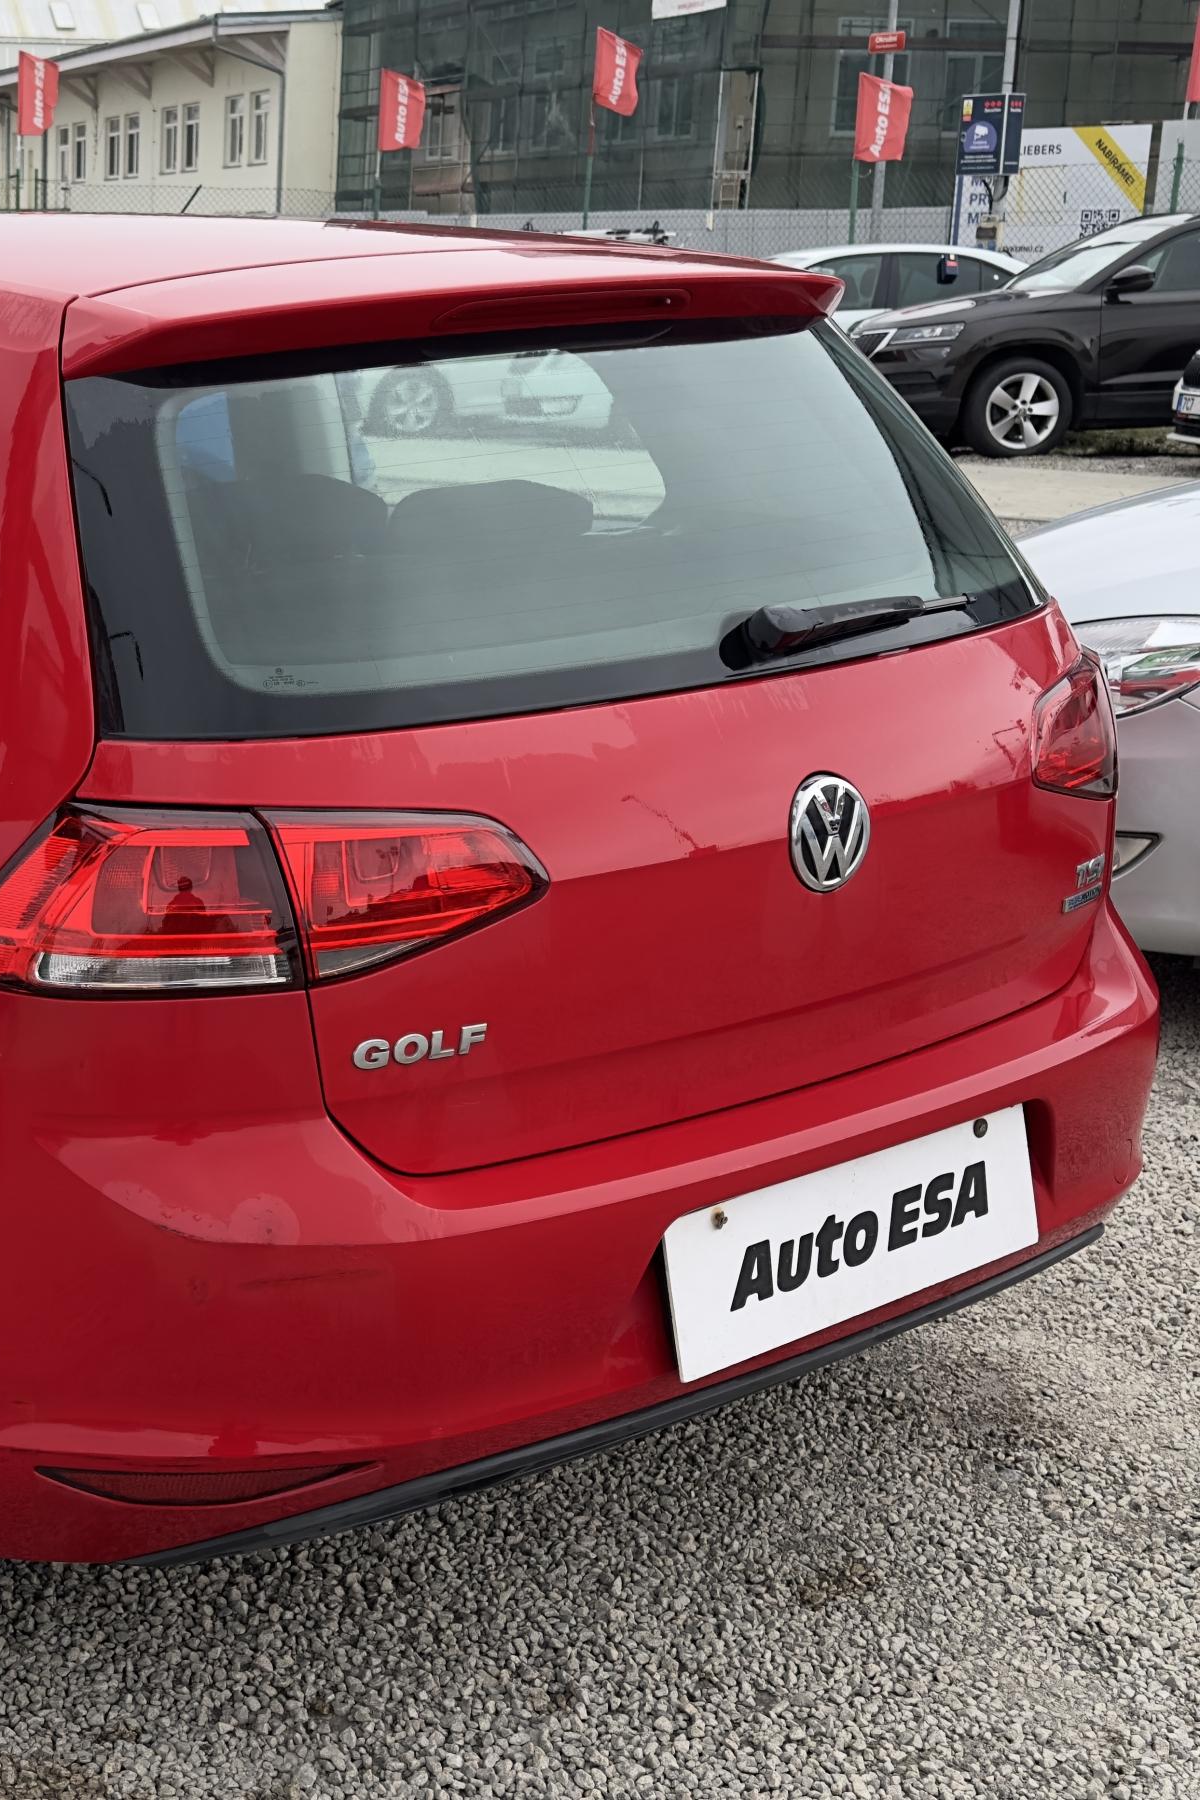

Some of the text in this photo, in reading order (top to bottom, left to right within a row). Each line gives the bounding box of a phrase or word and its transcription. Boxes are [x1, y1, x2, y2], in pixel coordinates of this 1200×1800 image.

[33, 91, 44, 129] Auto
[870, 115, 889, 158] Auto
[1021, 144, 1062, 156] IEBERS
[353, 1022, 488, 1070] GOLF
[730, 1160, 988, 1312] Auto ESA
